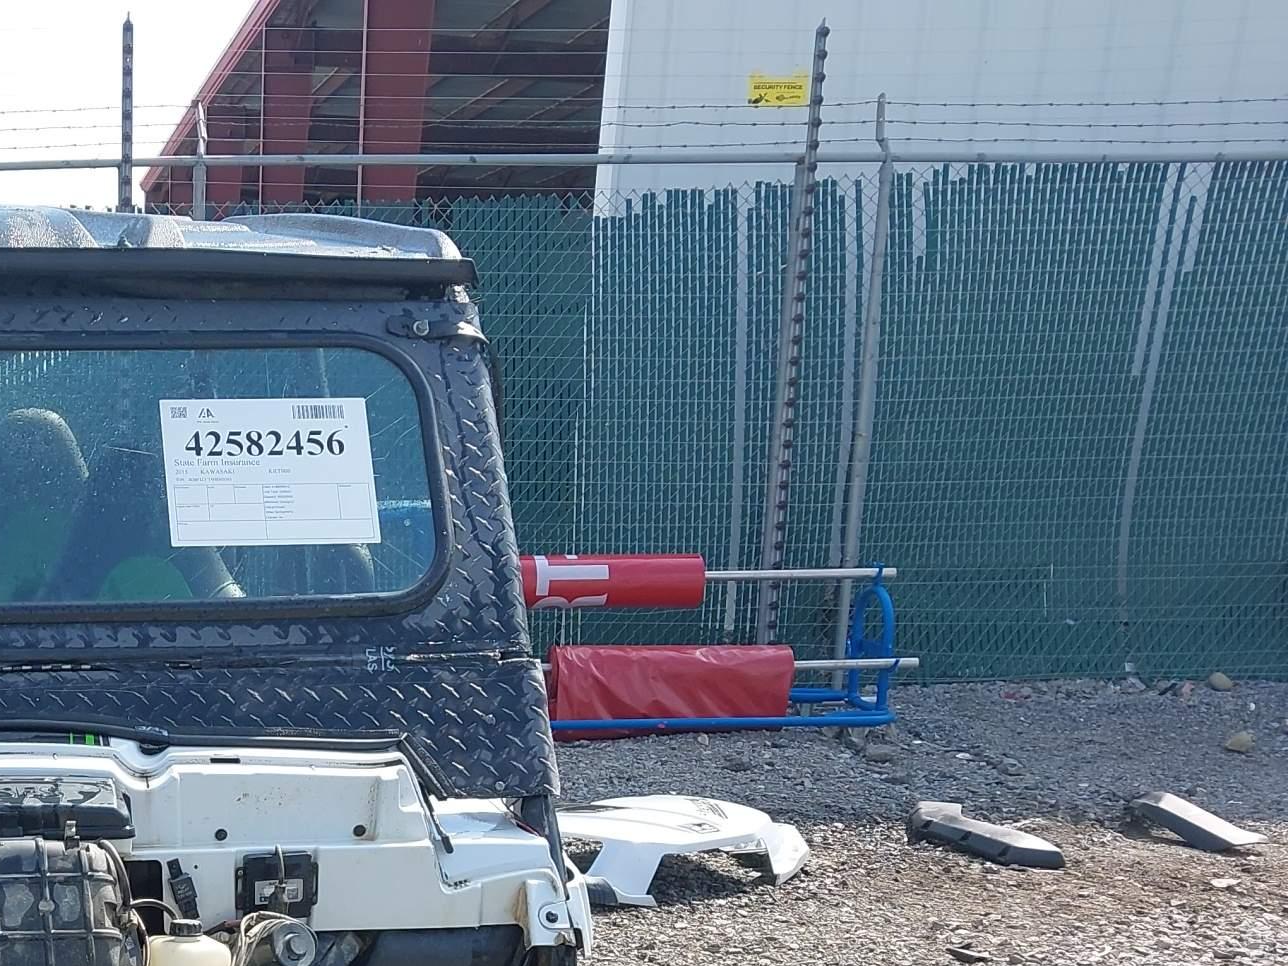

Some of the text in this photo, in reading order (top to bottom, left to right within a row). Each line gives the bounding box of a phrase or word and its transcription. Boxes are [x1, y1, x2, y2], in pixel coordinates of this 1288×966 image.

[185, 429, 345, 457] 42582456
[174, 458, 260, 467] State Farm Insurance
